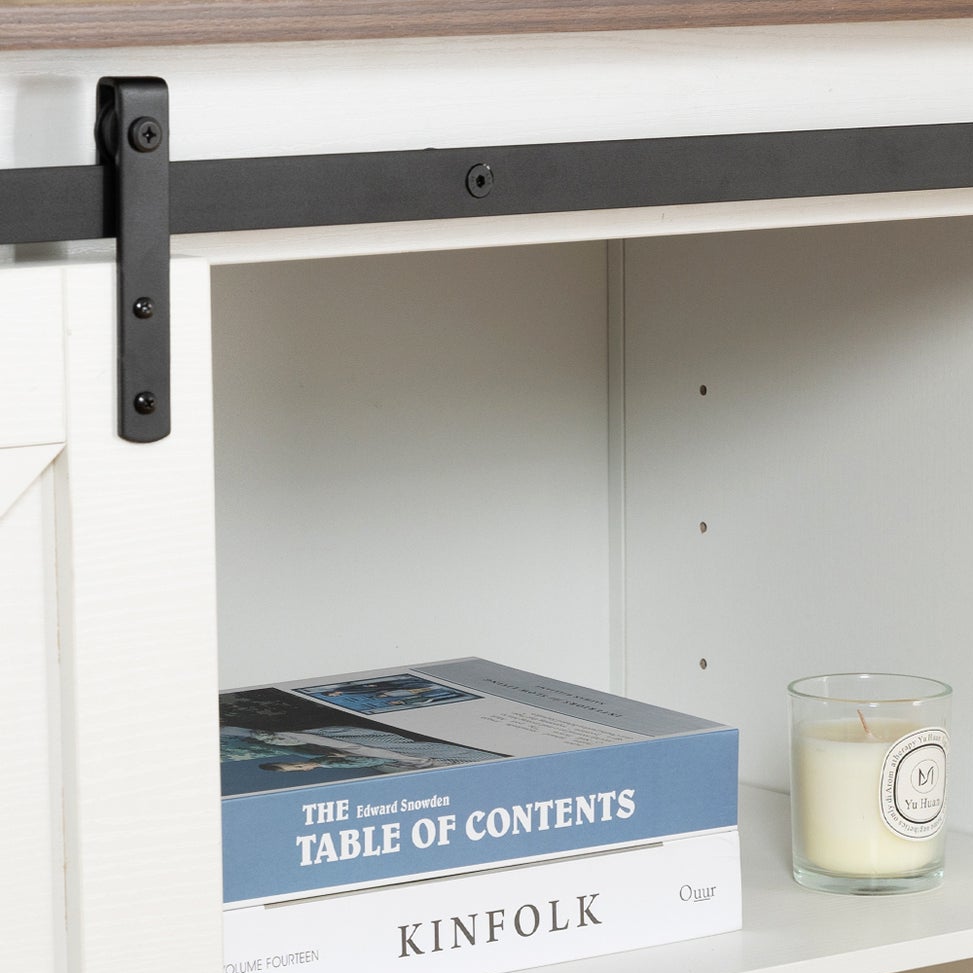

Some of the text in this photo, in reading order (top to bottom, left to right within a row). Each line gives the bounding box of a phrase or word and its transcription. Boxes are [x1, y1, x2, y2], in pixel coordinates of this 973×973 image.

[296, 788, 636, 867] TABLE OF CONTENTS
[302, 794, 450, 826] THE Edward Snowden
[905, 799, 918, 810] Yu
[265, 949, 319, 968] FOURTEEN
[397, 893, 602, 959] KINFOLK
[679, 884, 717, 901] Ouur
